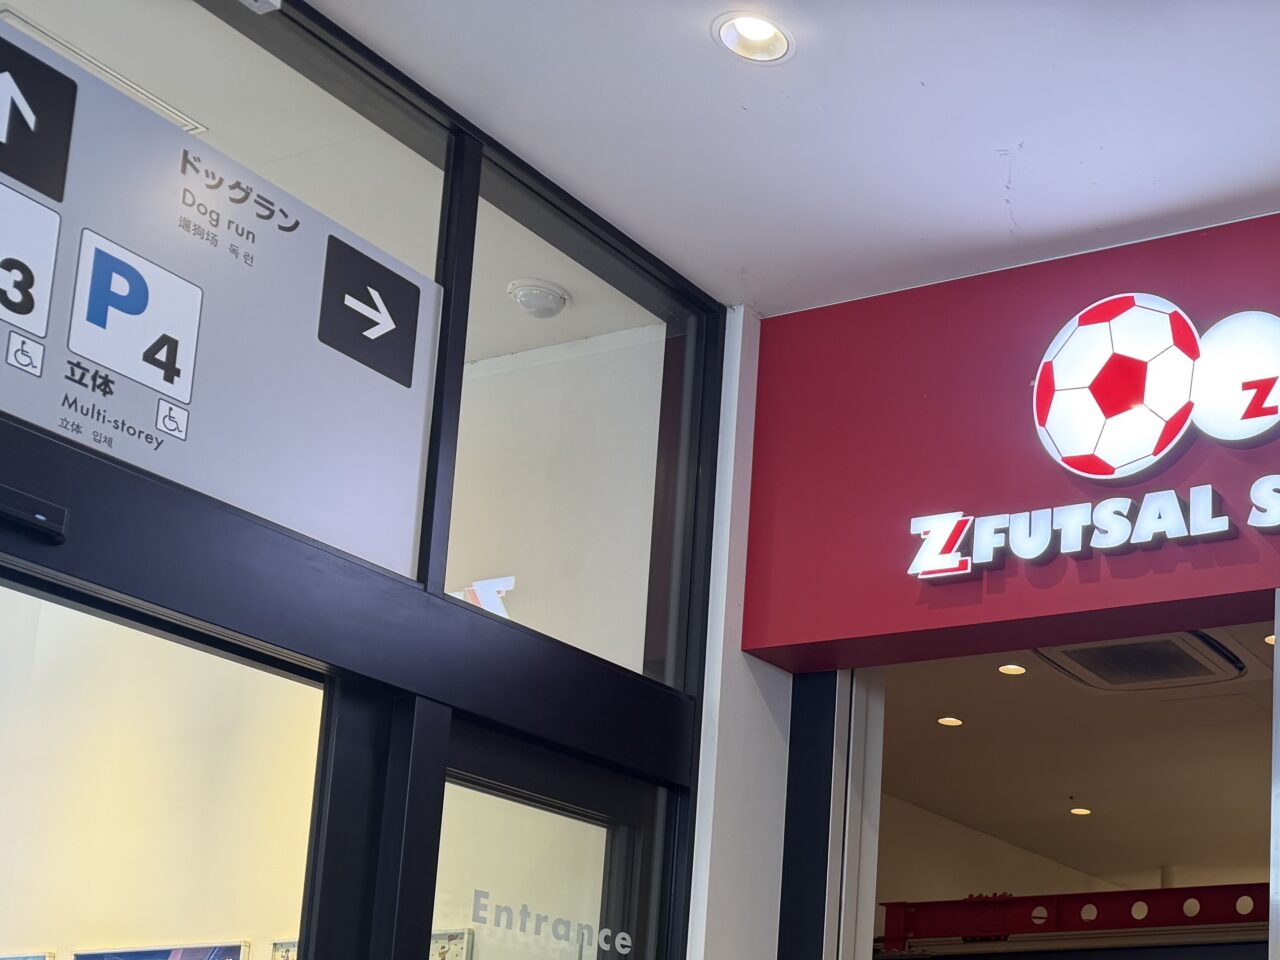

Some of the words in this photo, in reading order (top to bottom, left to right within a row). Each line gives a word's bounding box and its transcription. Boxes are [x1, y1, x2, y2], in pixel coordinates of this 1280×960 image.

[180, 148, 300, 233] ドッグラン
[181, 187, 220, 227] Dog
[227, 217, 256, 244] run
[85, 247, 150, 330] P
[64, 359, 115, 398] 立体
[142, 333, 182, 385] 4
[62, 393, 165, 451] Multi-storey
[473, 889, 632, 955] Entrance
